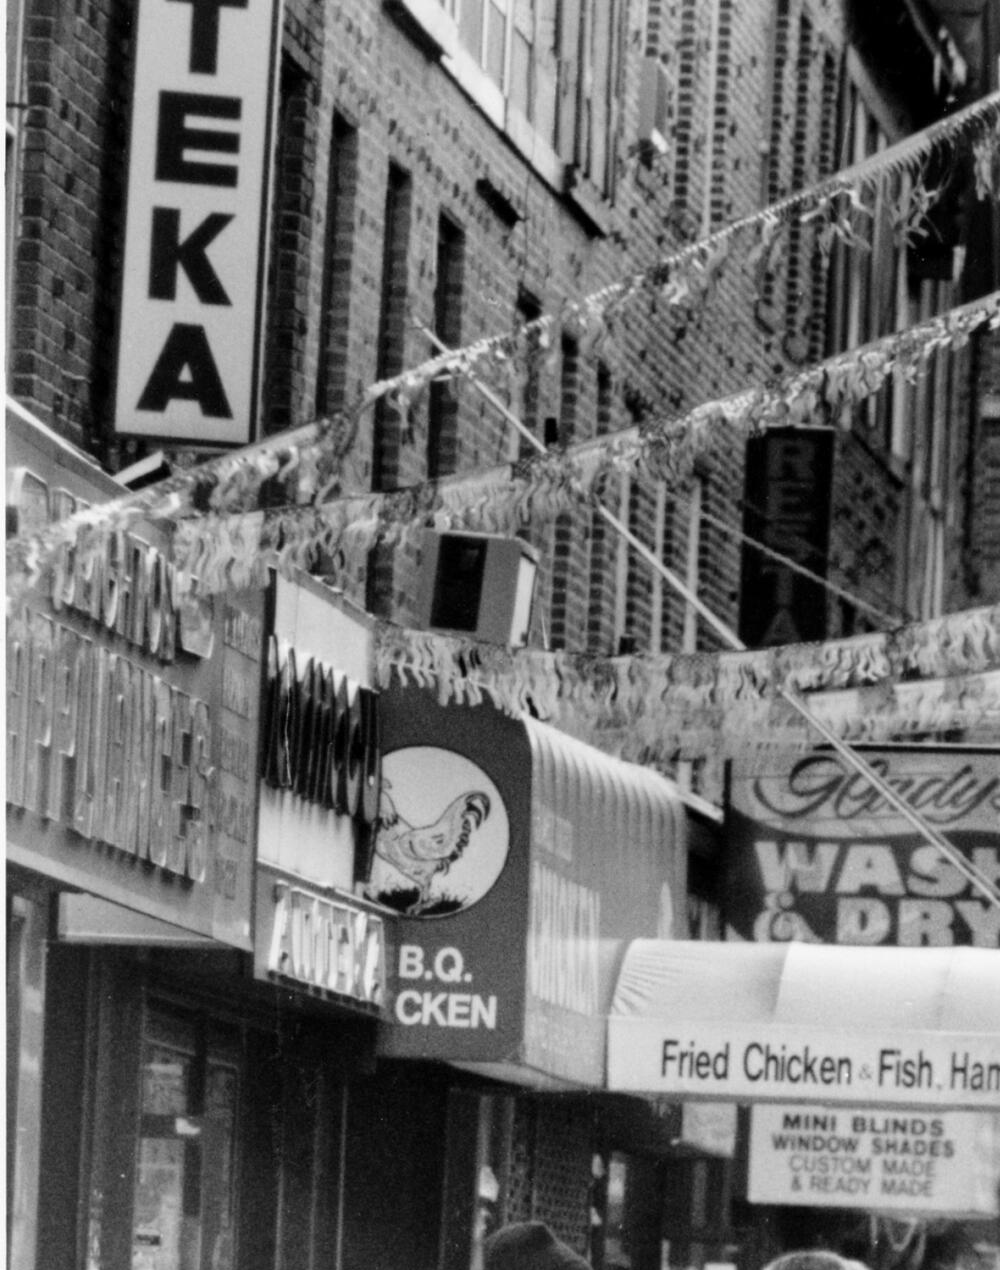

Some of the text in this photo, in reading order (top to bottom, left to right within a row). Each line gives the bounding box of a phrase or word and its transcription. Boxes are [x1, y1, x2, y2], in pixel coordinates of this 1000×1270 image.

[395, 989, 498, 1030] CKEN
[661, 1040, 730, 1080] Fried
[743, 1042, 852, 1085] Chicken
[782, 1113, 945, 1137] MINI BLINDS
[772, 1134, 955, 1158] WINDOW SHADES
[788, 1155, 937, 1178] CUSTOM MADE
[809, 1176, 871, 1195] READY
[881, 1179, 934, 1198] MADE
